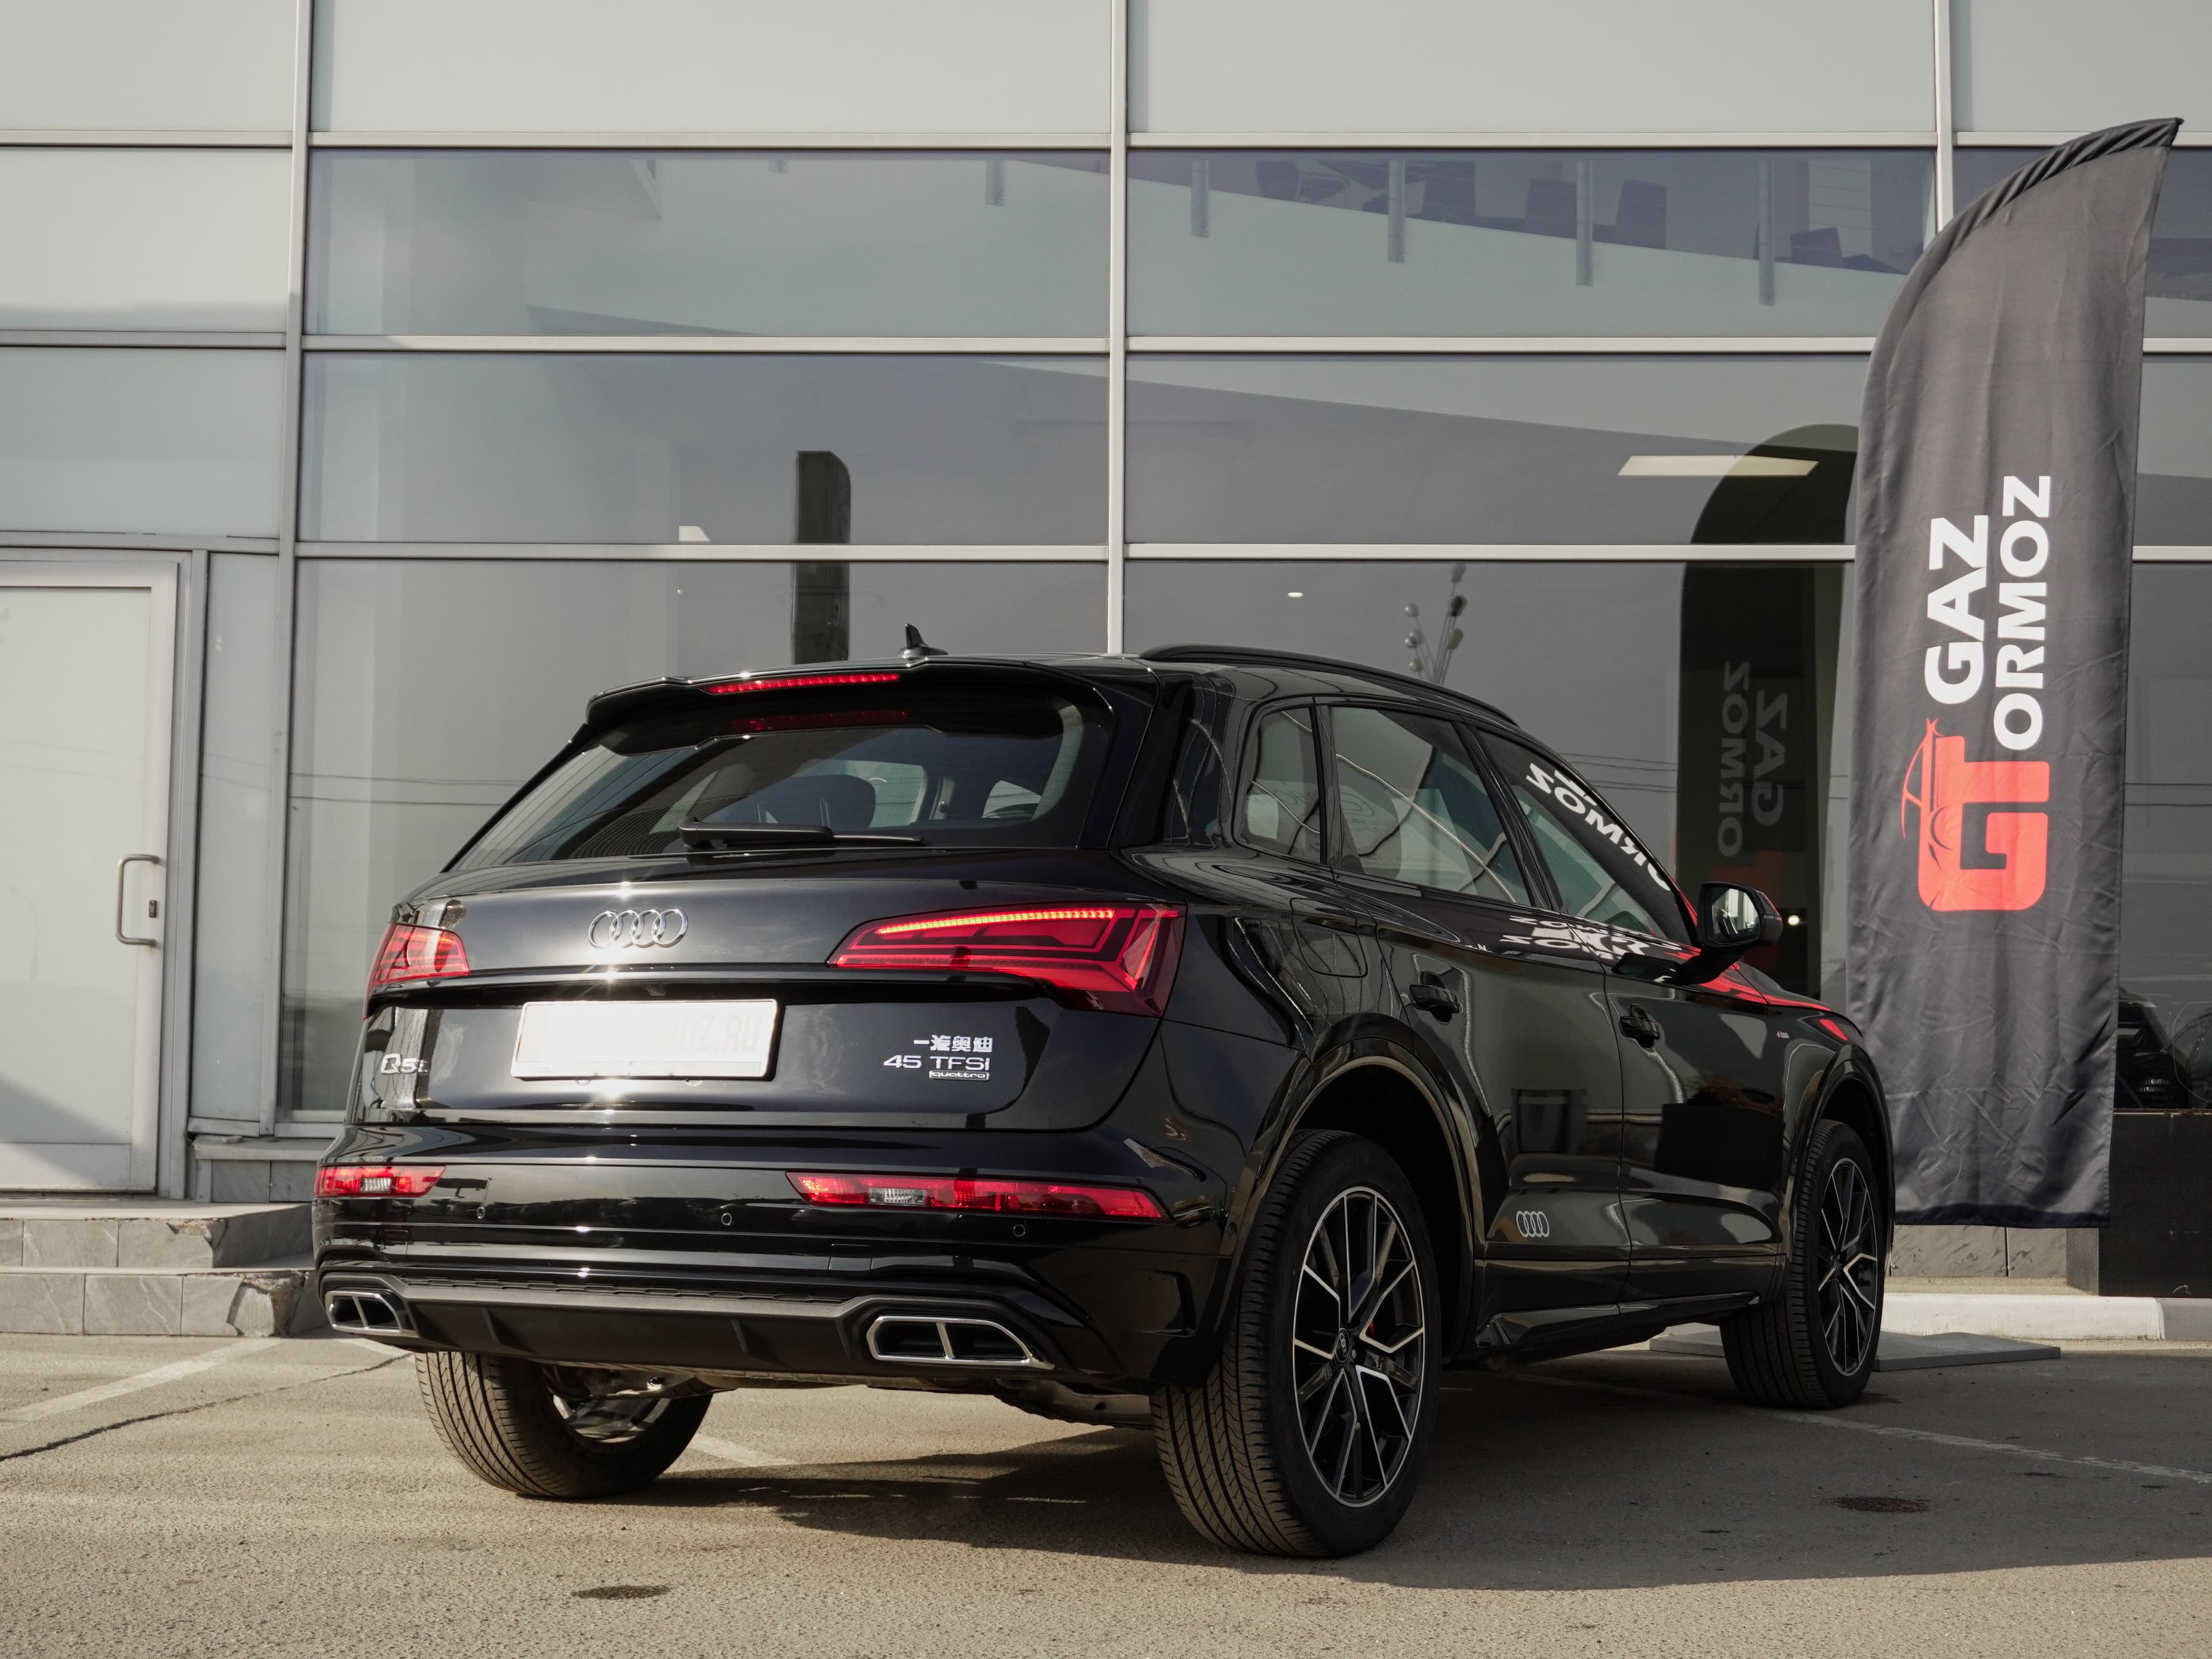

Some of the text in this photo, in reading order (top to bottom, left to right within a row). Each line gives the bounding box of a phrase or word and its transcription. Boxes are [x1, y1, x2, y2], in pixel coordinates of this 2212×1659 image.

[1925, 515, 1988, 704] GAZ
[1993, 476, 2051, 751] ORMOZ
[883, 1054, 990, 1071] 45 TFSI
[931, 1071, 987, 1080] quattro
